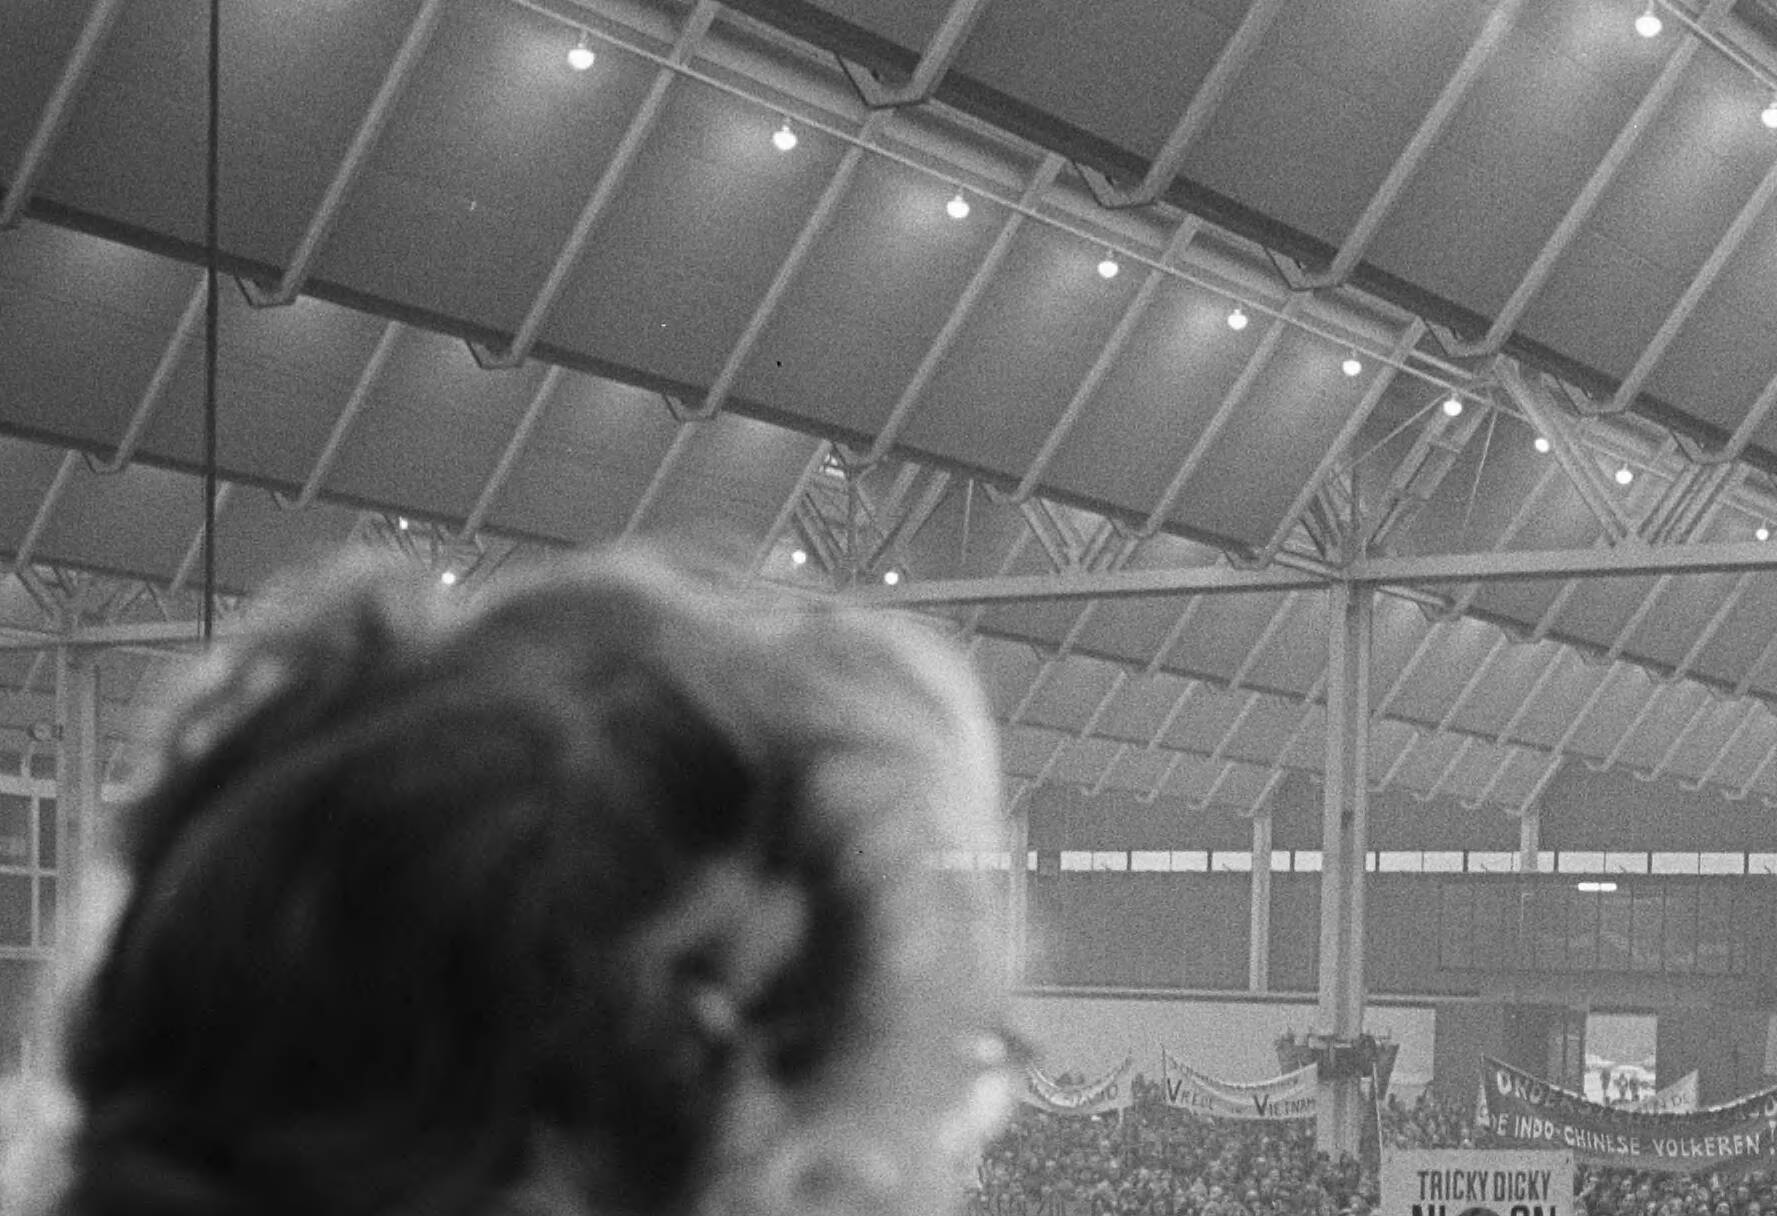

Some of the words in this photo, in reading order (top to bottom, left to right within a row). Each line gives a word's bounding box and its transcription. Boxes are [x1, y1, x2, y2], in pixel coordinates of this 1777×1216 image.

[1252, 1093, 1317, 1116] VIETNAM
[1514, 1114, 1641, 1156] INDO-CHINESE
[1651, 1132, 1761, 1159] VOLKEREN
[1417, 1170, 1489, 1202] TRICKY
[1493, 1170, 1552, 1201] DICKY
